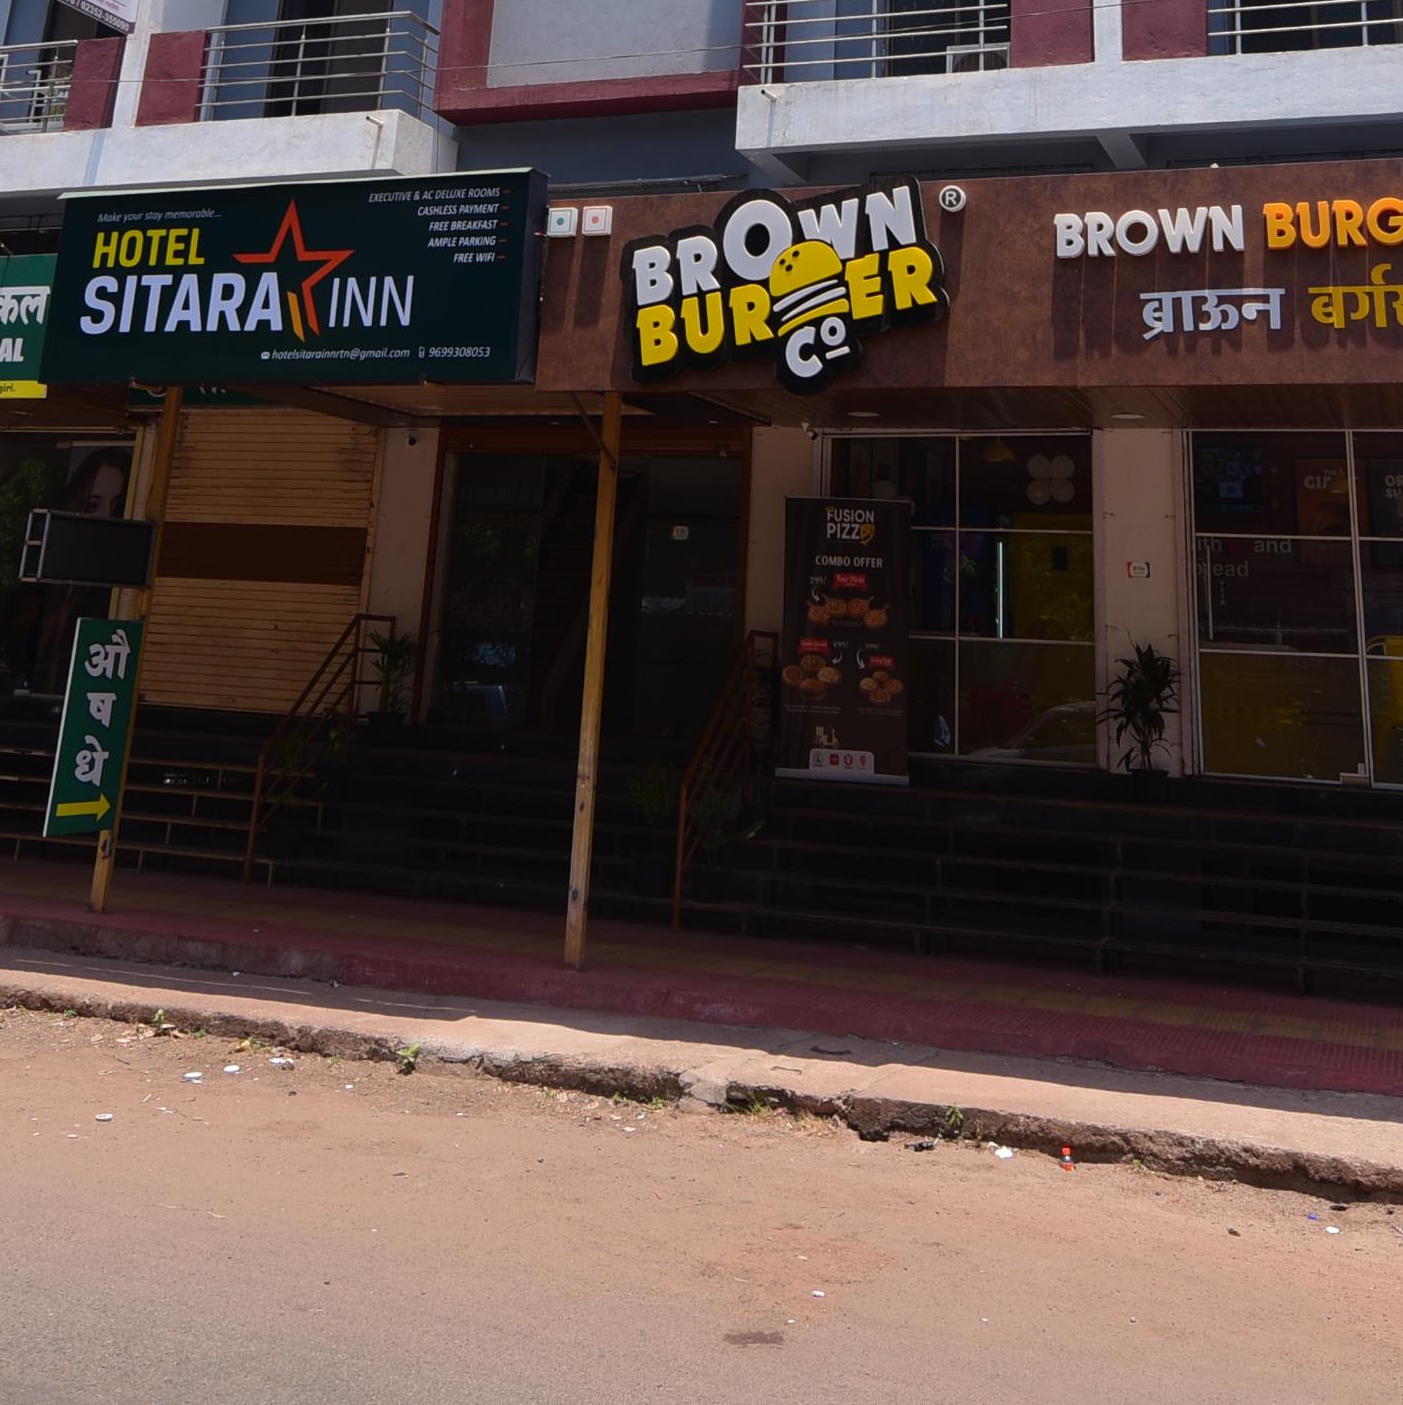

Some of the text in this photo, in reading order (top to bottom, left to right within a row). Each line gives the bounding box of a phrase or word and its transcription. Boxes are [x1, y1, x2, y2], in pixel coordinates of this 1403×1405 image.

[369, 192, 411, 202] EXECUTIVE
[422, 190, 433, 200] AC
[435, 189, 466, 199] DELUXE
[468, 188, 500, 198] ROOMS
[417, 204, 500, 216] CASHLESS PAYMENT
[97, 212, 118, 223] Make
[122, 213, 143, 224] your
[145, 211, 162, 222] stay
[429, 220, 498, 231] FREE BREAKFAST
[1054, 205, 1244, 258] BROWN
[93, 228, 205, 268] HOTEL
[428, 236, 496, 247] AMPLE PARKING
[633, 186, 916, 305] BROWN
[453, 252, 495, 263] FREE WIFI
[80, 272, 414, 335] SITARA INN
[1139, 288, 1285, 340] ब्राऊन
[428, 347, 490, 358] 9699308053
[827, 508, 875, 524] FUSION
[815, 555, 883, 569] COMBO OFFER
